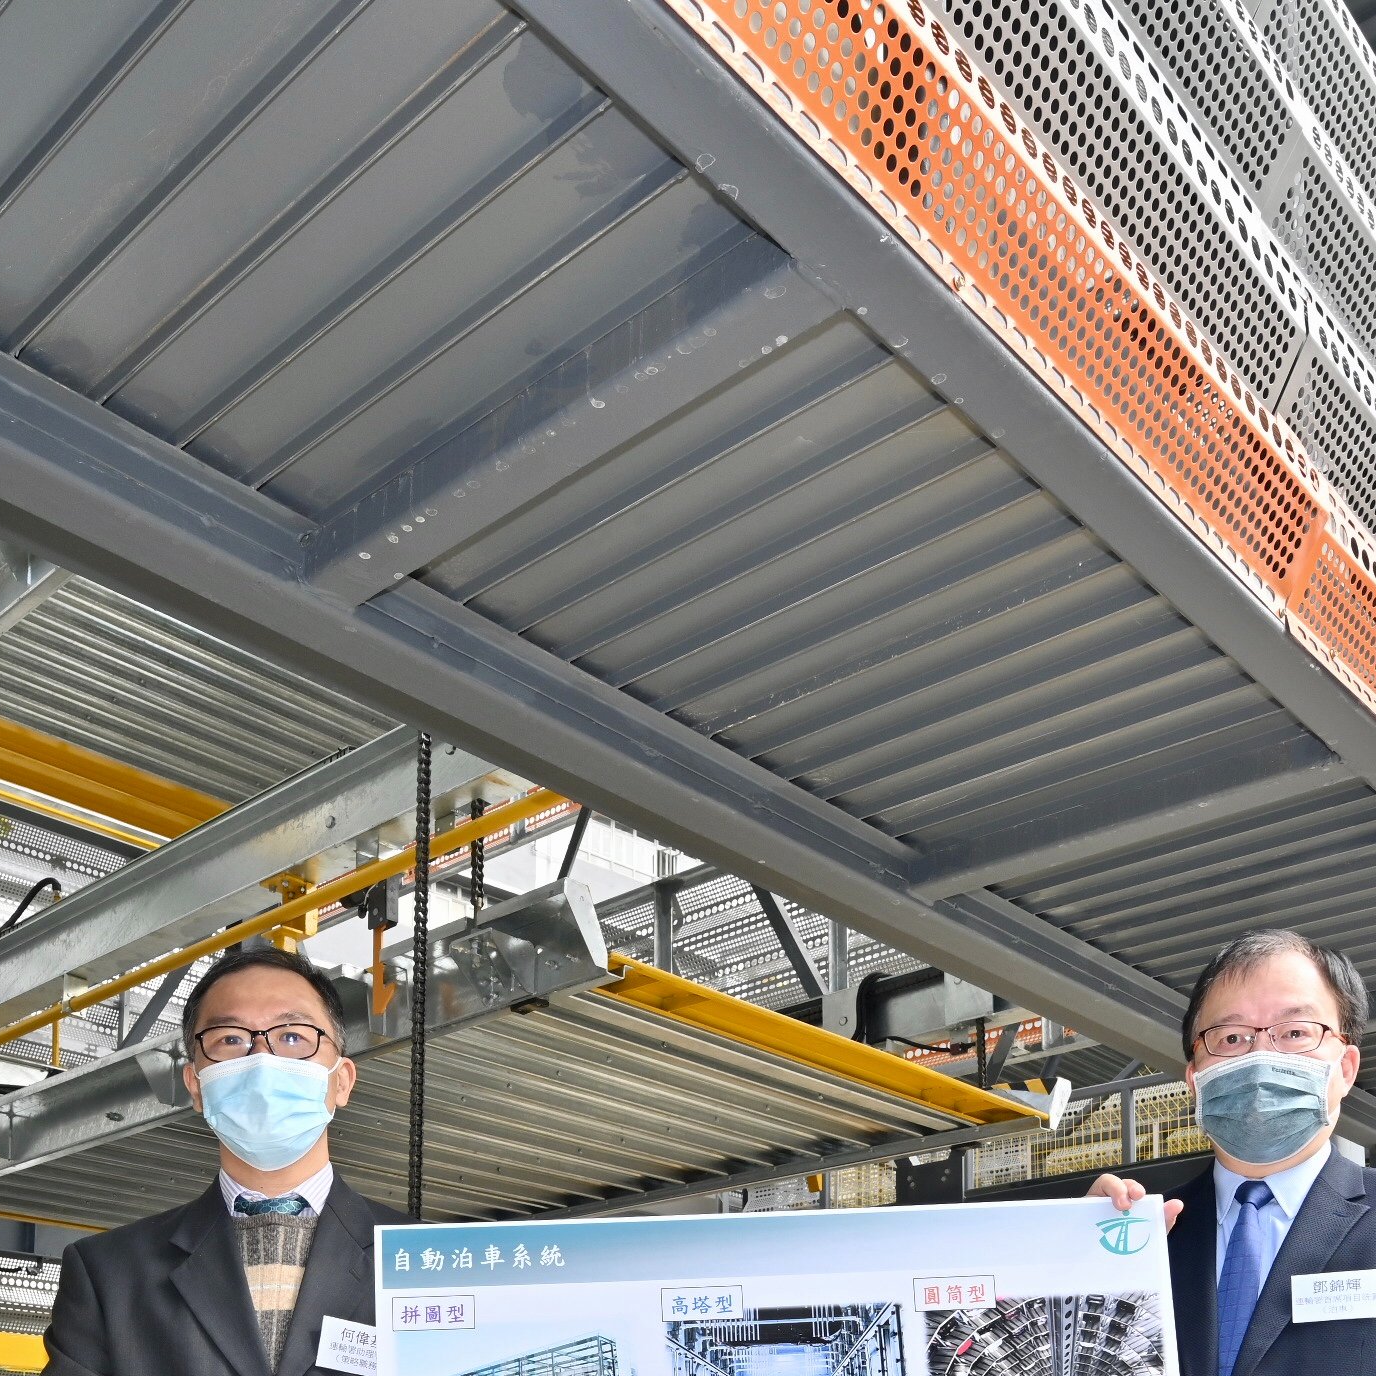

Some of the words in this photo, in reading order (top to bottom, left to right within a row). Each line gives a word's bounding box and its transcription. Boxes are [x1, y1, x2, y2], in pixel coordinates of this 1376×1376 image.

[392, 1244, 566, 1272] 自動泊車系統
[670, 1293, 735, 1317] 高塔型
[923, 1284, 986, 1305] 圓筒型
[400, 1303, 466, 1325] 拼圖型
